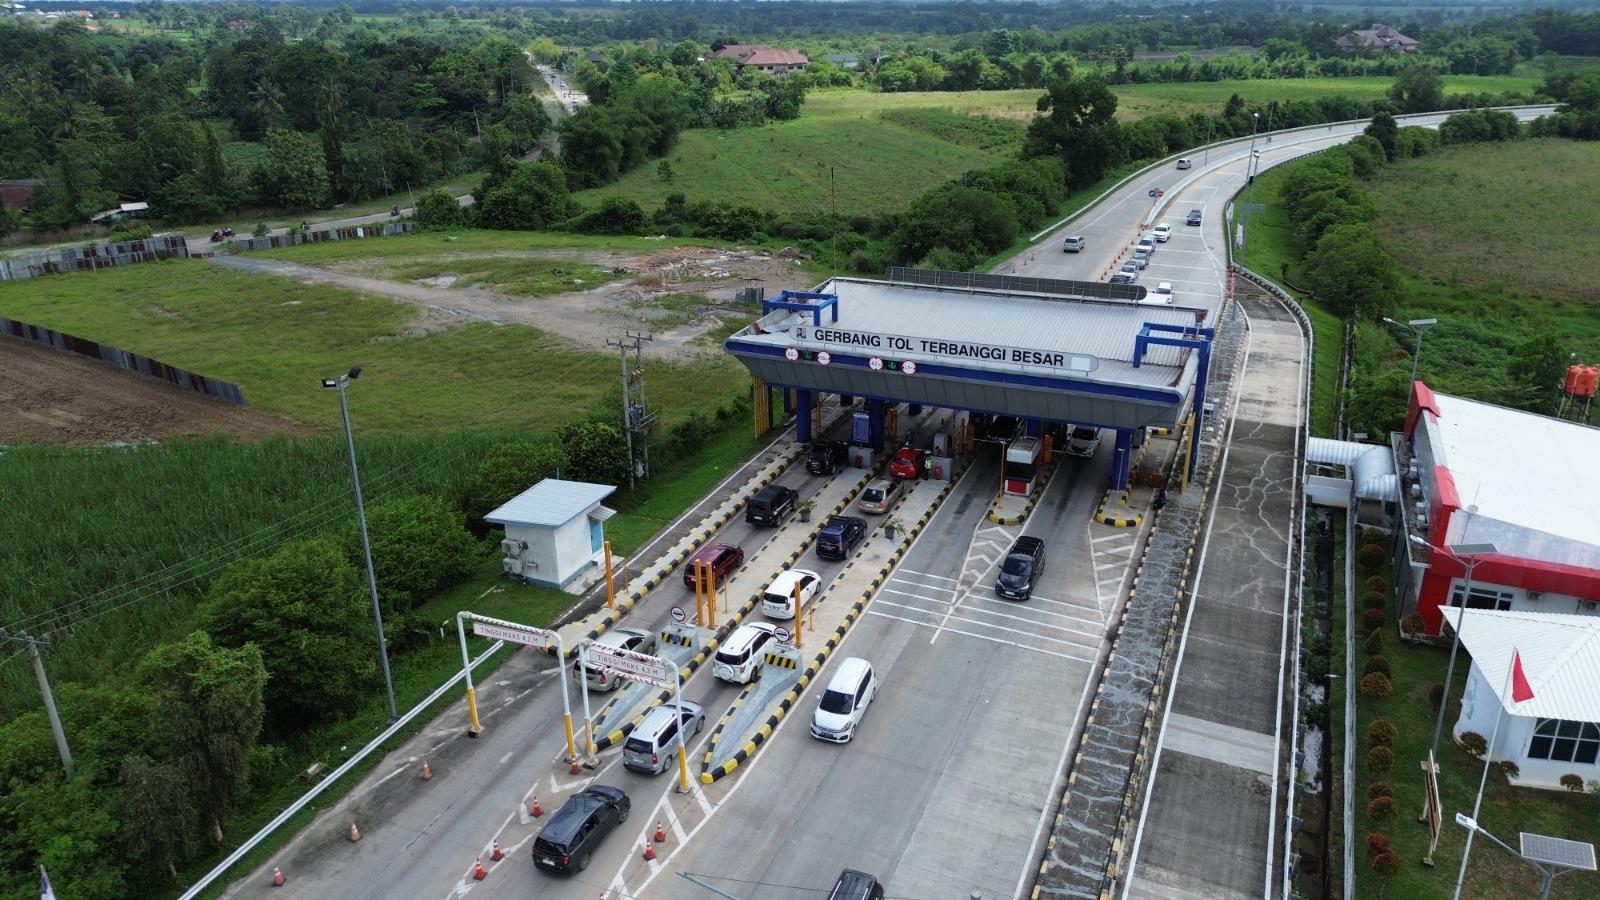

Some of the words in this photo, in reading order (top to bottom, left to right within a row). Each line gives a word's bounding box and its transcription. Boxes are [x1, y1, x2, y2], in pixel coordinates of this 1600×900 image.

[814, 329, 881, 348] GERBANG
[886, 336, 914, 351] TOL
[919, 340, 1006, 361] TERBANGGI
[1011, 349, 1065, 367] BESAR
[481, 627, 502, 637] TINGGI
[503, 632, 520, 641] MAKS
[598, 654, 620, 665] TINGGI
[621, 660, 639, 671] MAKS
